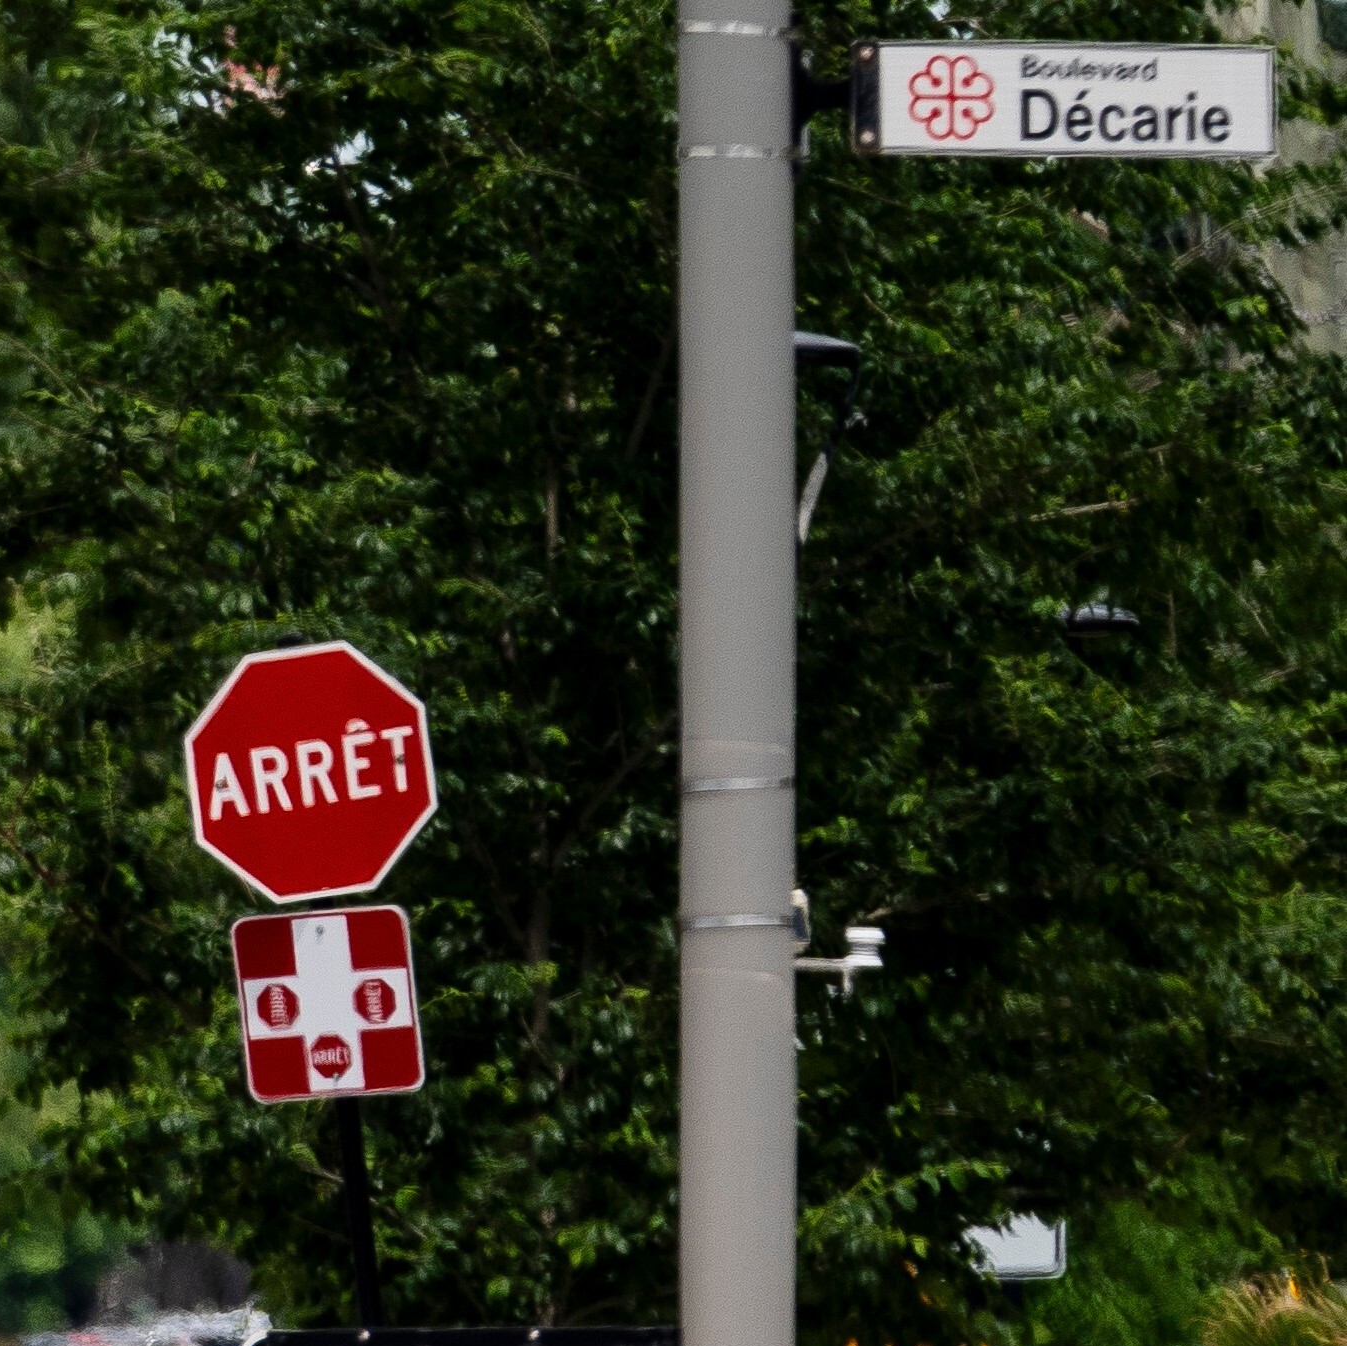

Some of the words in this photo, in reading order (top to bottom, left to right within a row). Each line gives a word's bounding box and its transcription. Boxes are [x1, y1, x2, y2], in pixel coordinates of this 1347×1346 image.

[1020, 54, 1158, 81] Boulevard
[1020, 89, 1231, 143] Décarie
[209, 718, 414, 821] ARRÊT
